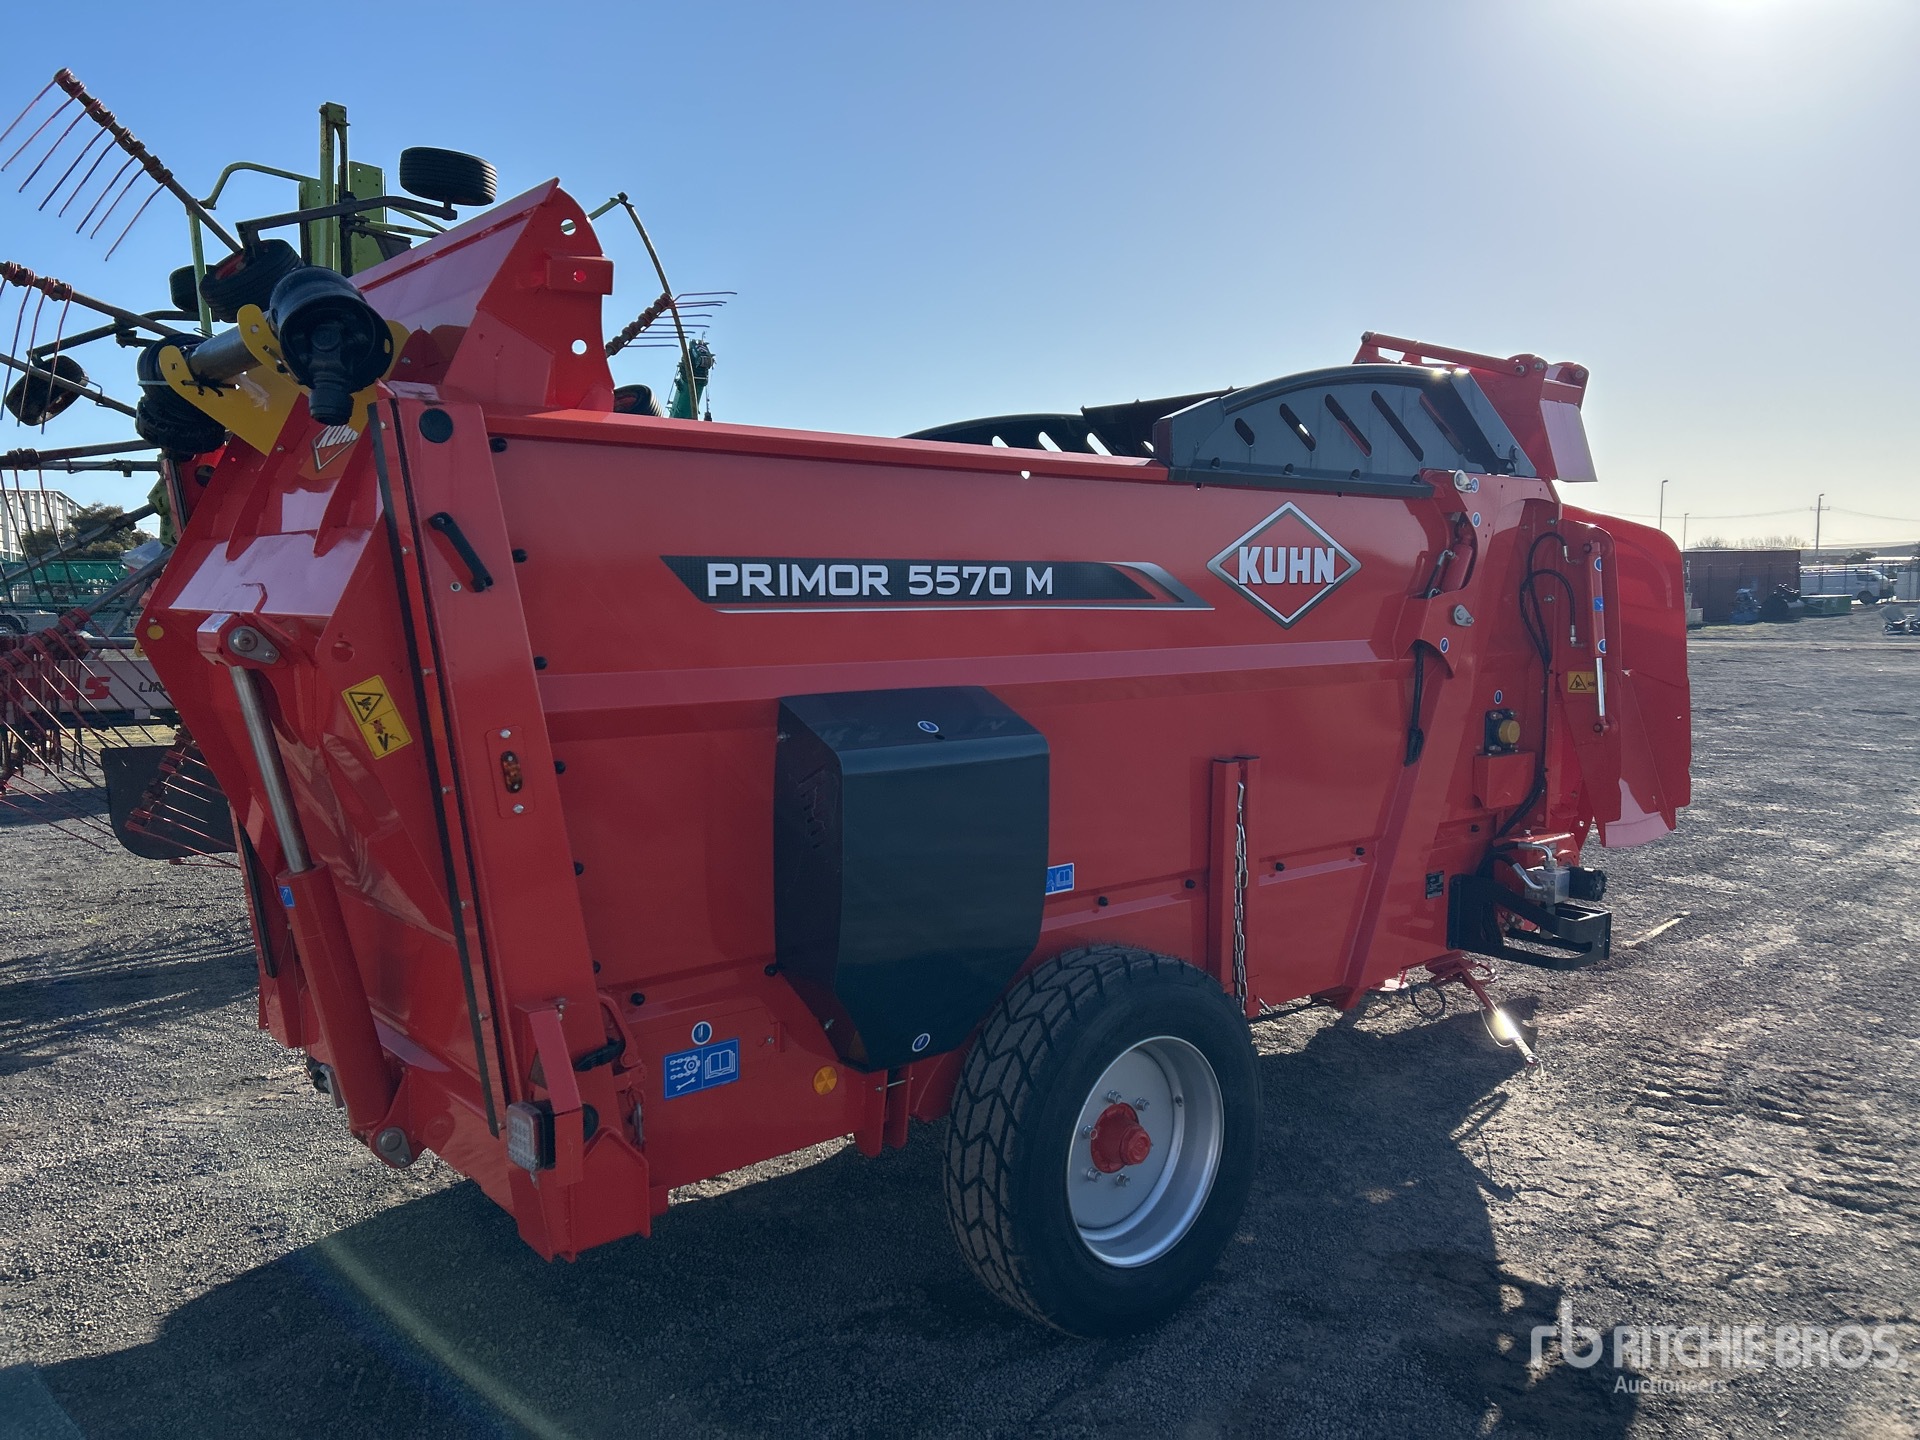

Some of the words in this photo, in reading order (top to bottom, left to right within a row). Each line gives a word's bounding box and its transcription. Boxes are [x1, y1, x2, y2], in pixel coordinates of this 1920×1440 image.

[707, 563, 891, 597] PRIMOR
[908, 565, 1012, 596] 5570
[1026, 566, 1053, 595] M
[1238, 546, 1335, 584] KUHN
